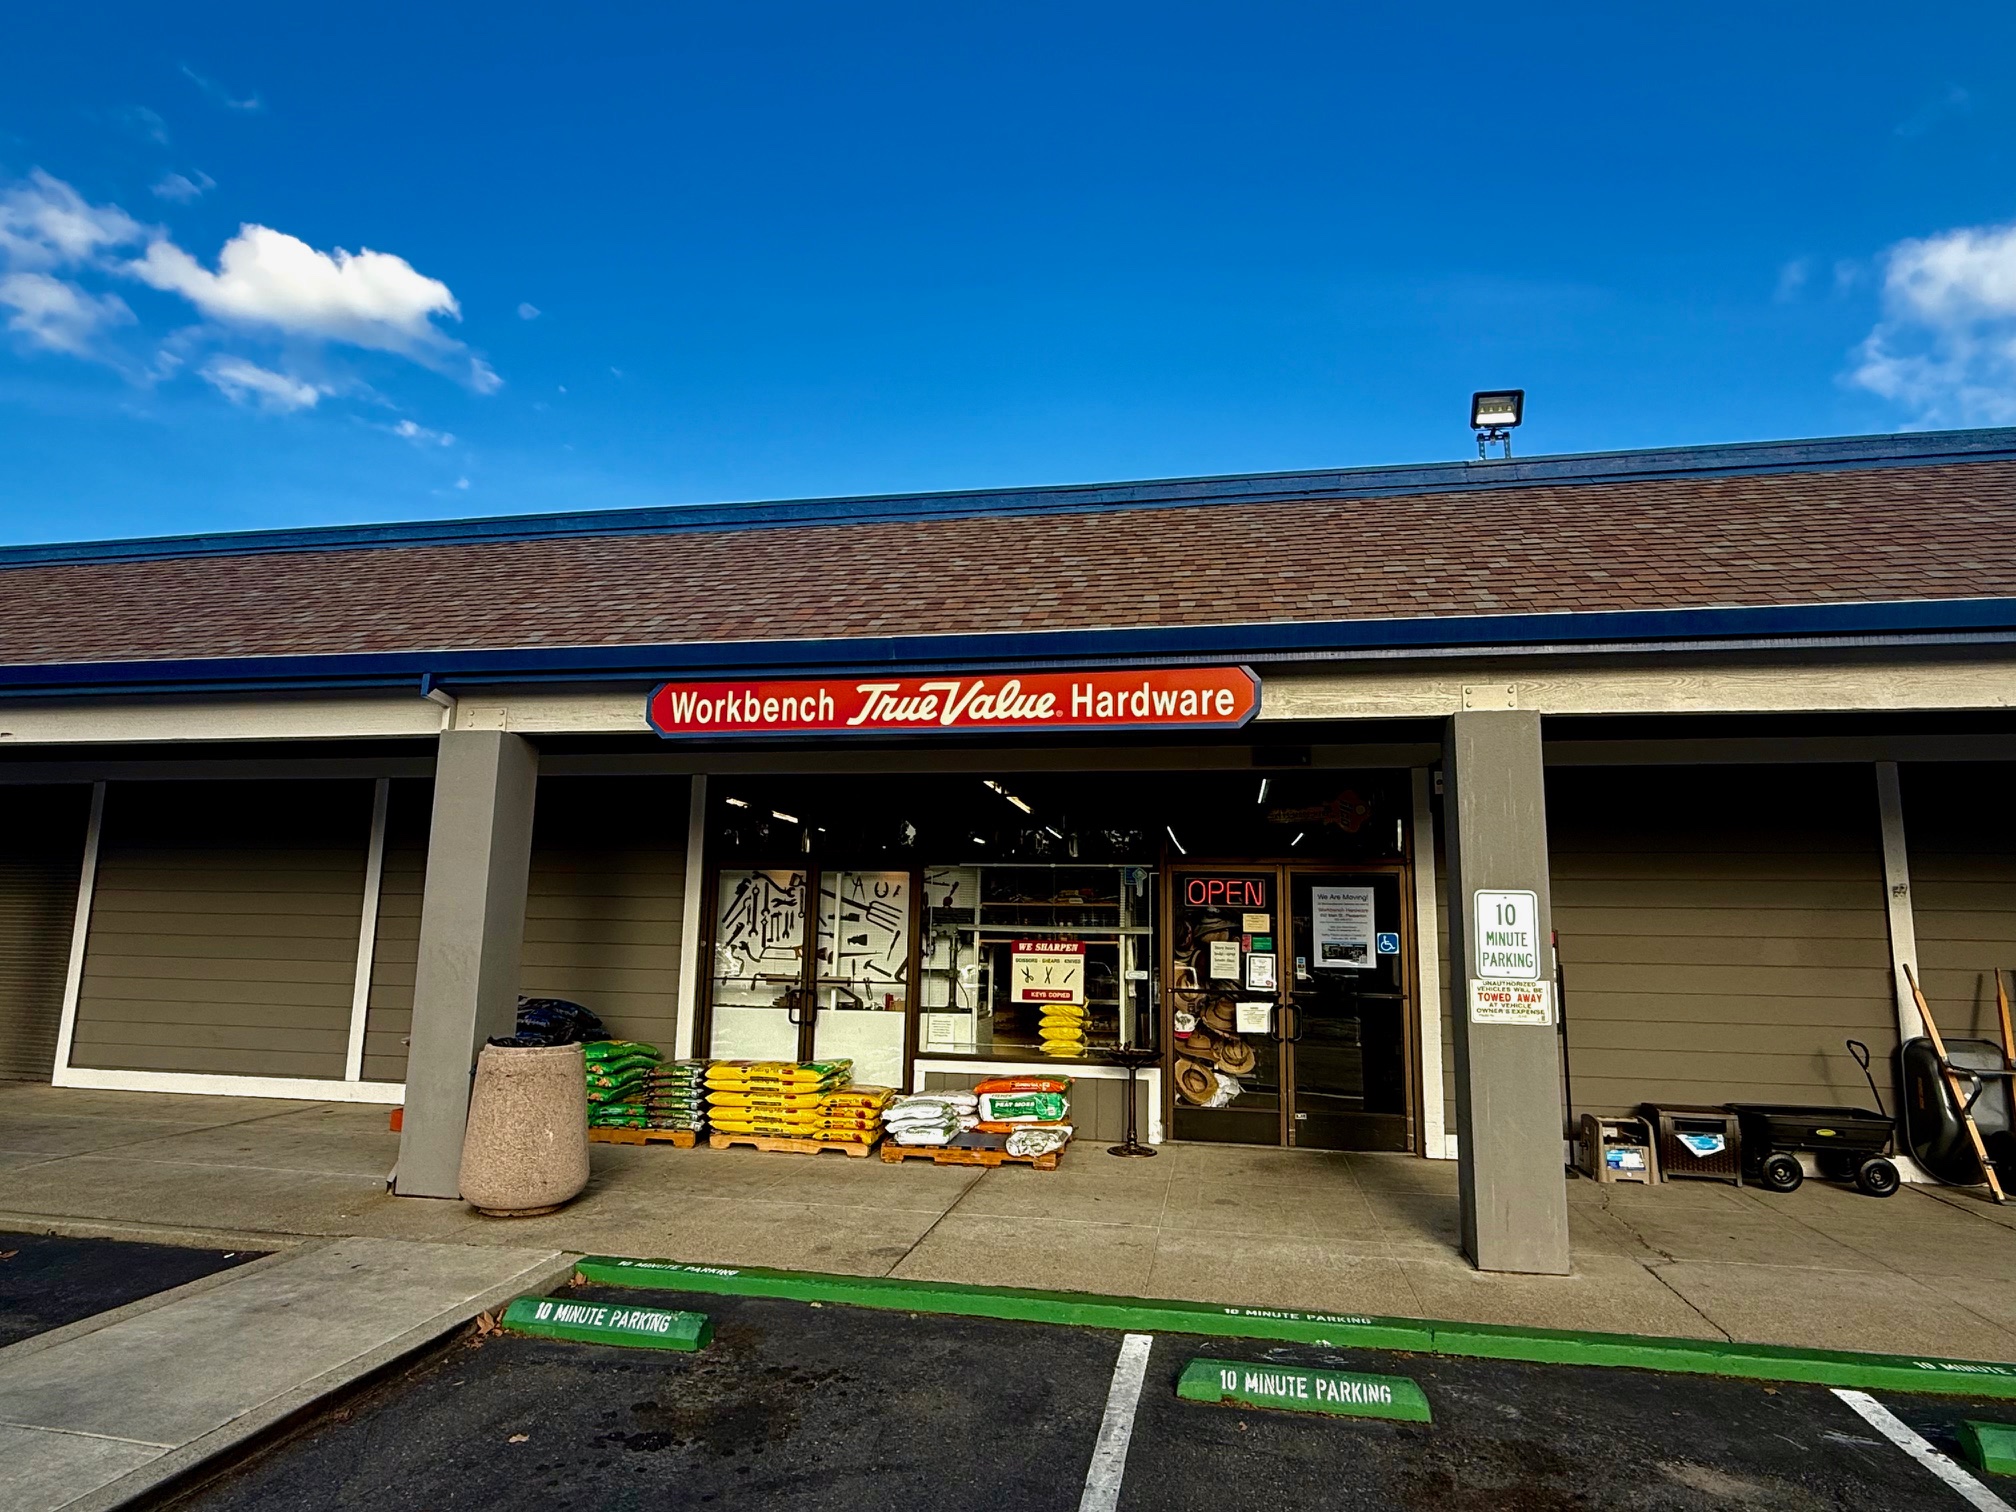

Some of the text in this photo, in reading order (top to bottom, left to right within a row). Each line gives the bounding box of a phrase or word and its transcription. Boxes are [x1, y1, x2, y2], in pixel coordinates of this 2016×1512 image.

[672, 688, 834, 725] Workbench
[1072, 681, 1236, 718] Hardware
[1188, 880, 1262, 906] OPEN
[1496, 903, 1517, 926] 10
[1018, 942, 1079, 952] WE SHARPEN
[1486, 931, 1528, 947] MINUTE
[1482, 952, 1534, 968] PARKING
[1477, 992, 1543, 1003] TOWED AWAY
[636, 1262, 683, 1271] MINUTE
[684, 1266, 740, 1276] PARKING
[535, 1301, 672, 1333] 10 MINUTE PARKING
[1245, 1309, 1300, 1320] MINUTE
[1306, 1314, 1372, 1325] PARKING
[1912, 1361, 1937, 1370] 10
[1938, 1363, 2013, 1376] MINUTE
[1220, 1369, 1392, 1404] 10 MINUTE PARKING
